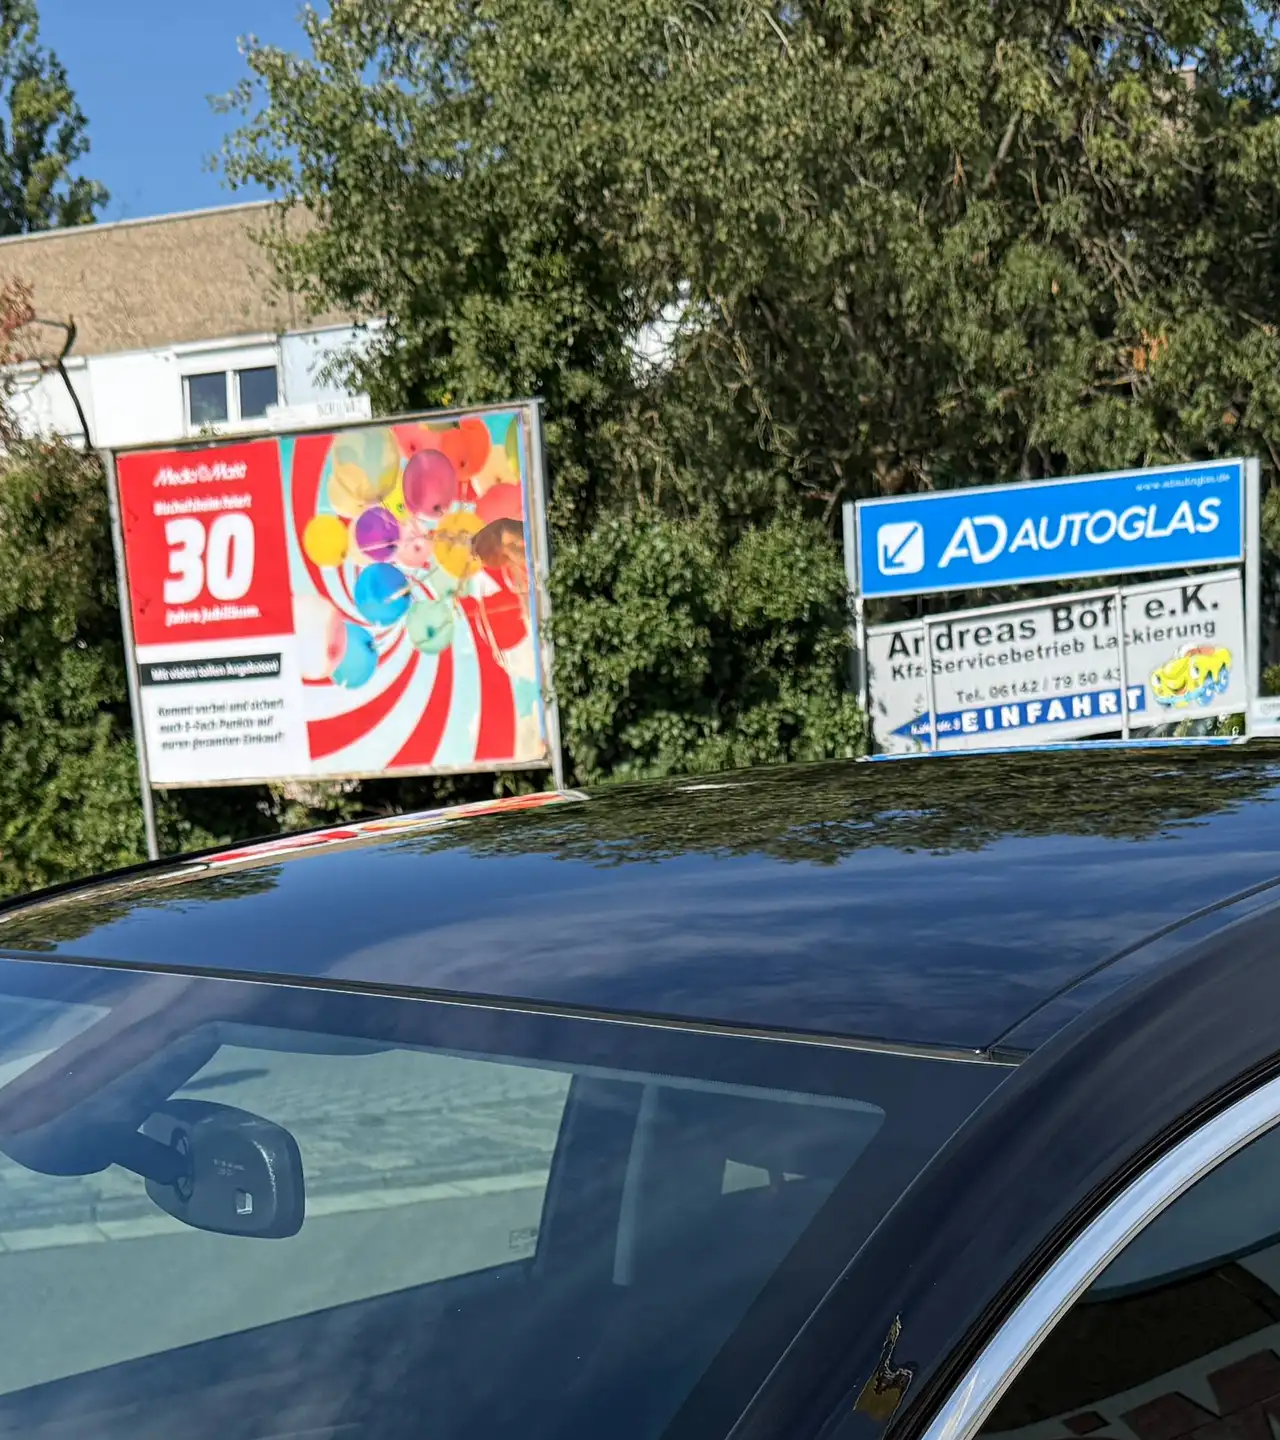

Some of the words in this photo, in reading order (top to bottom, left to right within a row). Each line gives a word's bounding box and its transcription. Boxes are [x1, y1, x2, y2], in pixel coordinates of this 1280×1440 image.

[1008, 497, 1222, 554] AUTOGLAS
[163, 511, 256, 605] 30
[1145, 584, 1219, 620] e.K.
[956, 689, 986, 704] Tel.
[961, 688, 1142, 733] EINFAHRT
